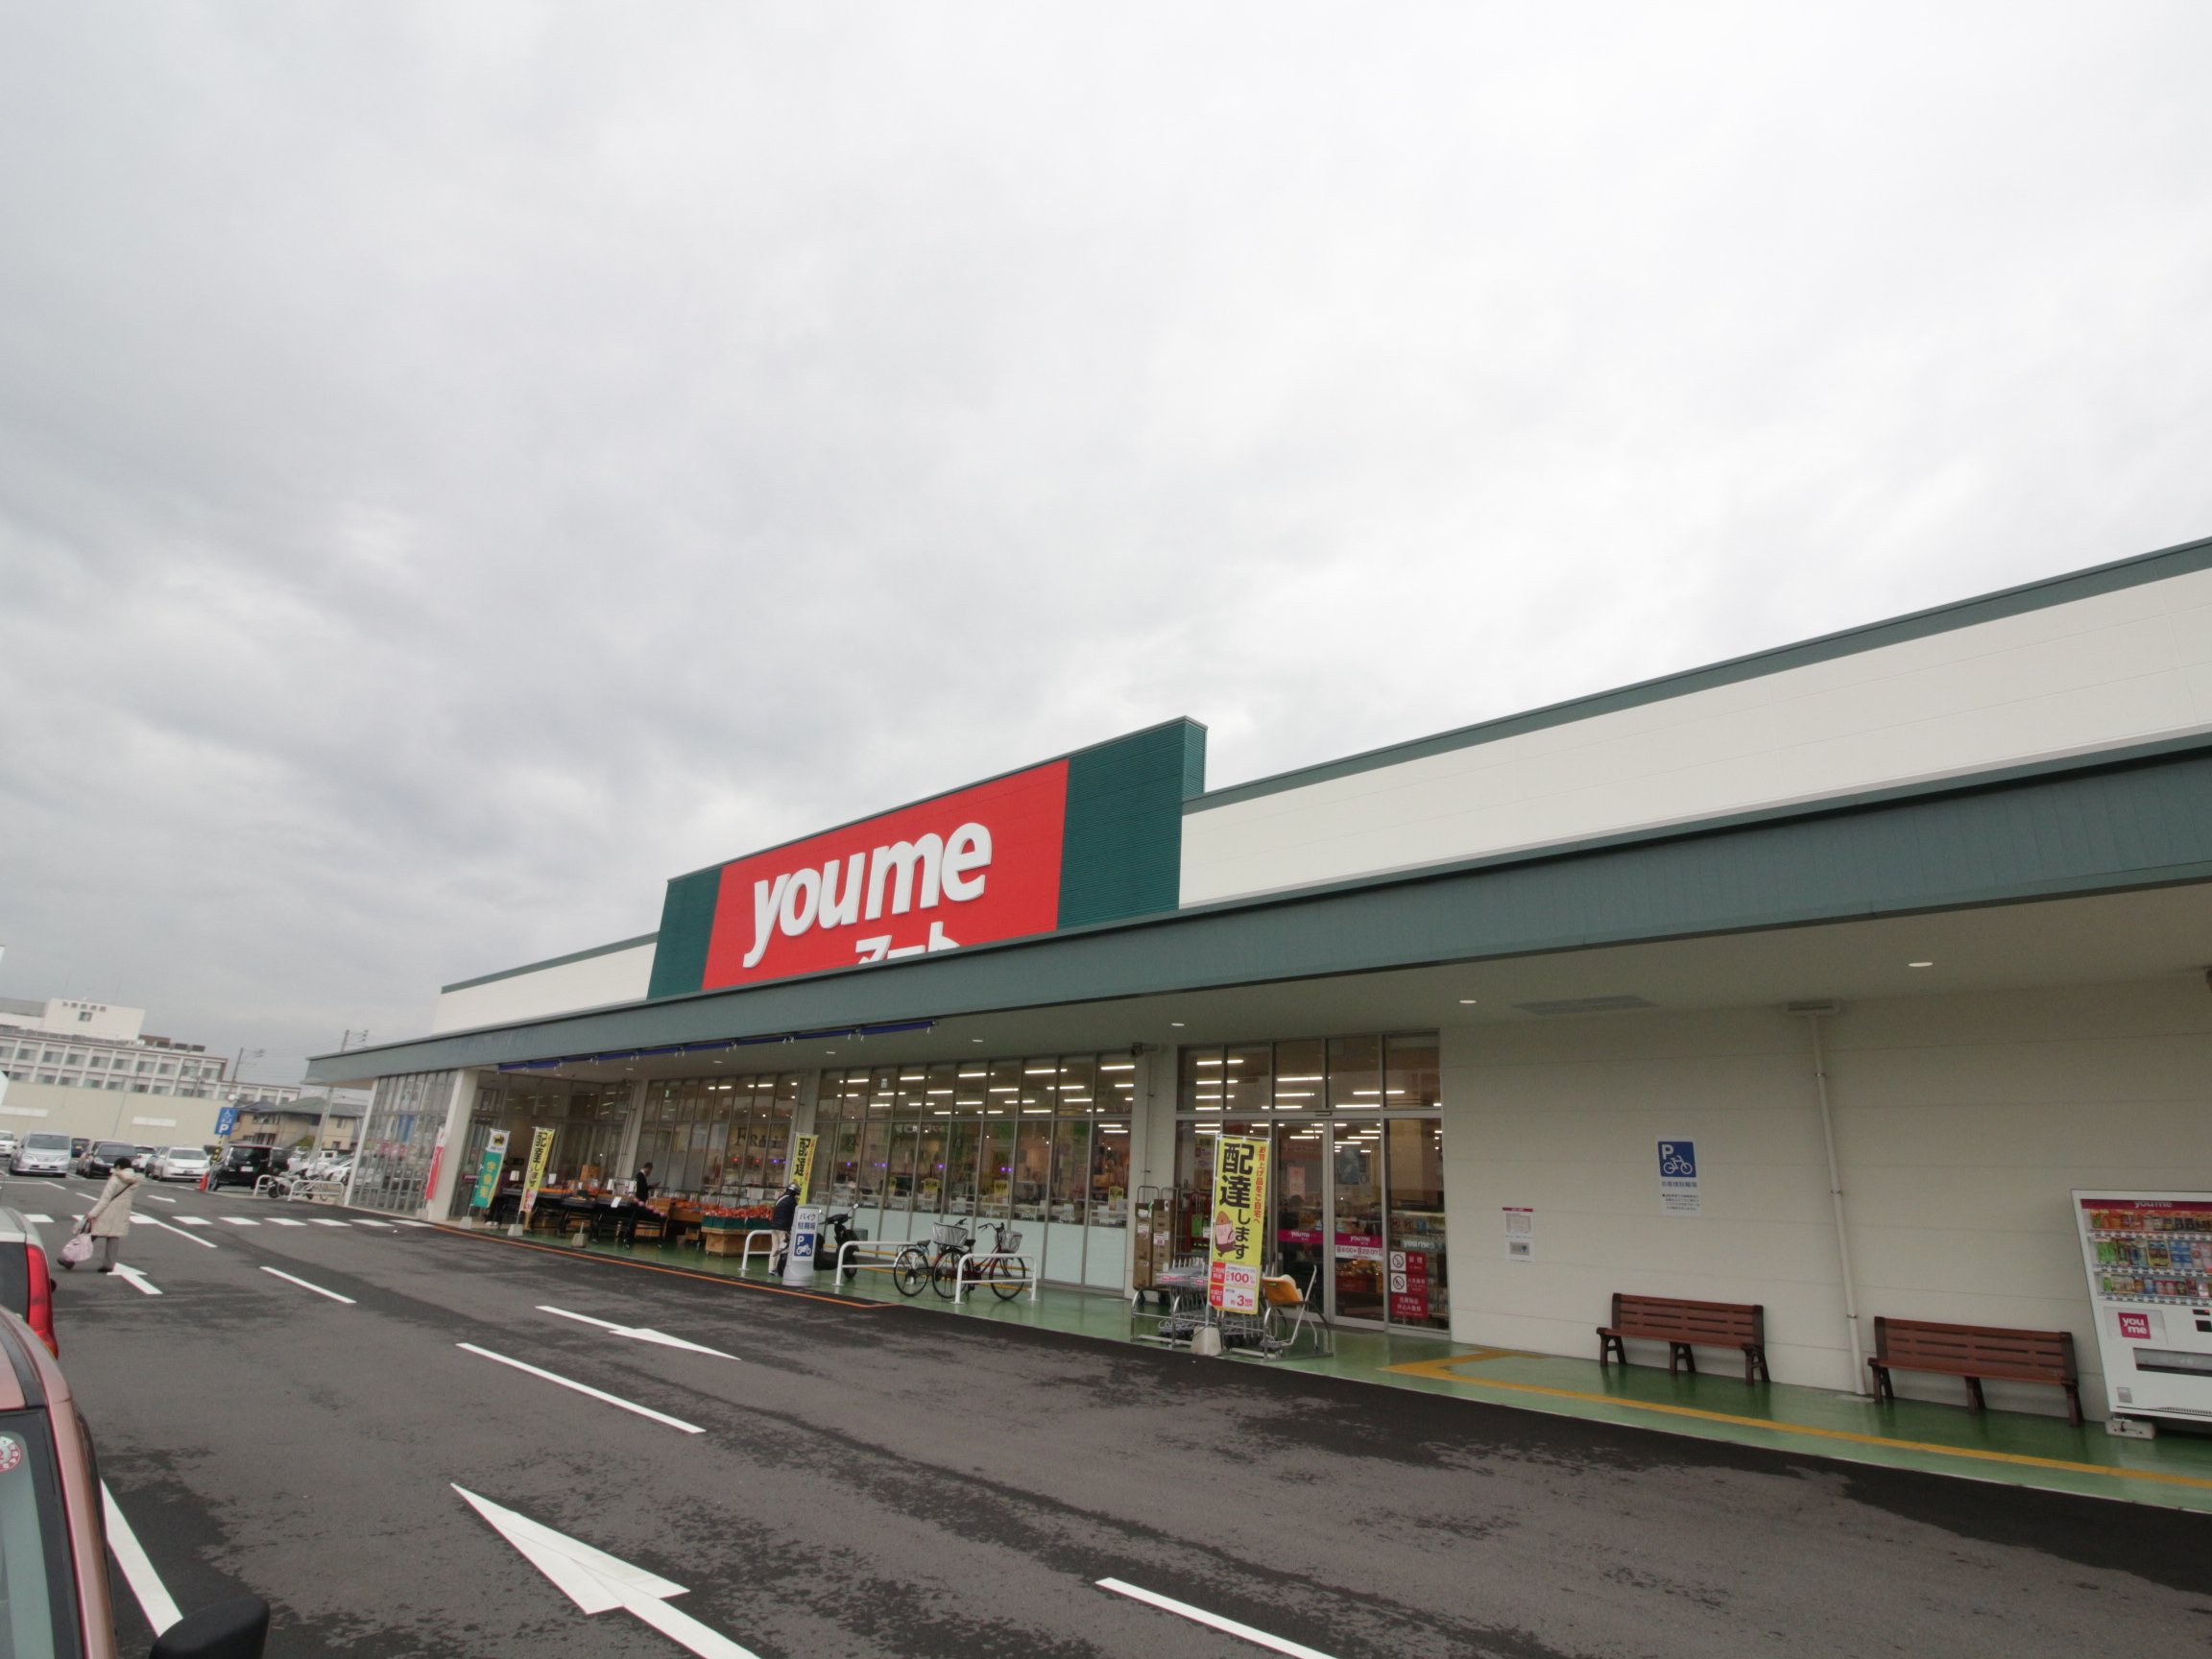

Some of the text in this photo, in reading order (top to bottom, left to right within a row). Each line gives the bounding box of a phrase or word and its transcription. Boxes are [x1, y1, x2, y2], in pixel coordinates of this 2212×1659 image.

[742, 822, 992, 968] youme
[219, 1124, 229, 1133] P
[1661, 1143, 1674, 1160] P
[1219, 1142, 1254, 1260] 配達します
[799, 1213, 816, 1221] バイク
[797, 1236, 805, 1245] P
[1230, 1271, 1249, 1284] 100
[2122, 1317, 2145, 1327] you
[2128, 1326, 2148, 1334] me
